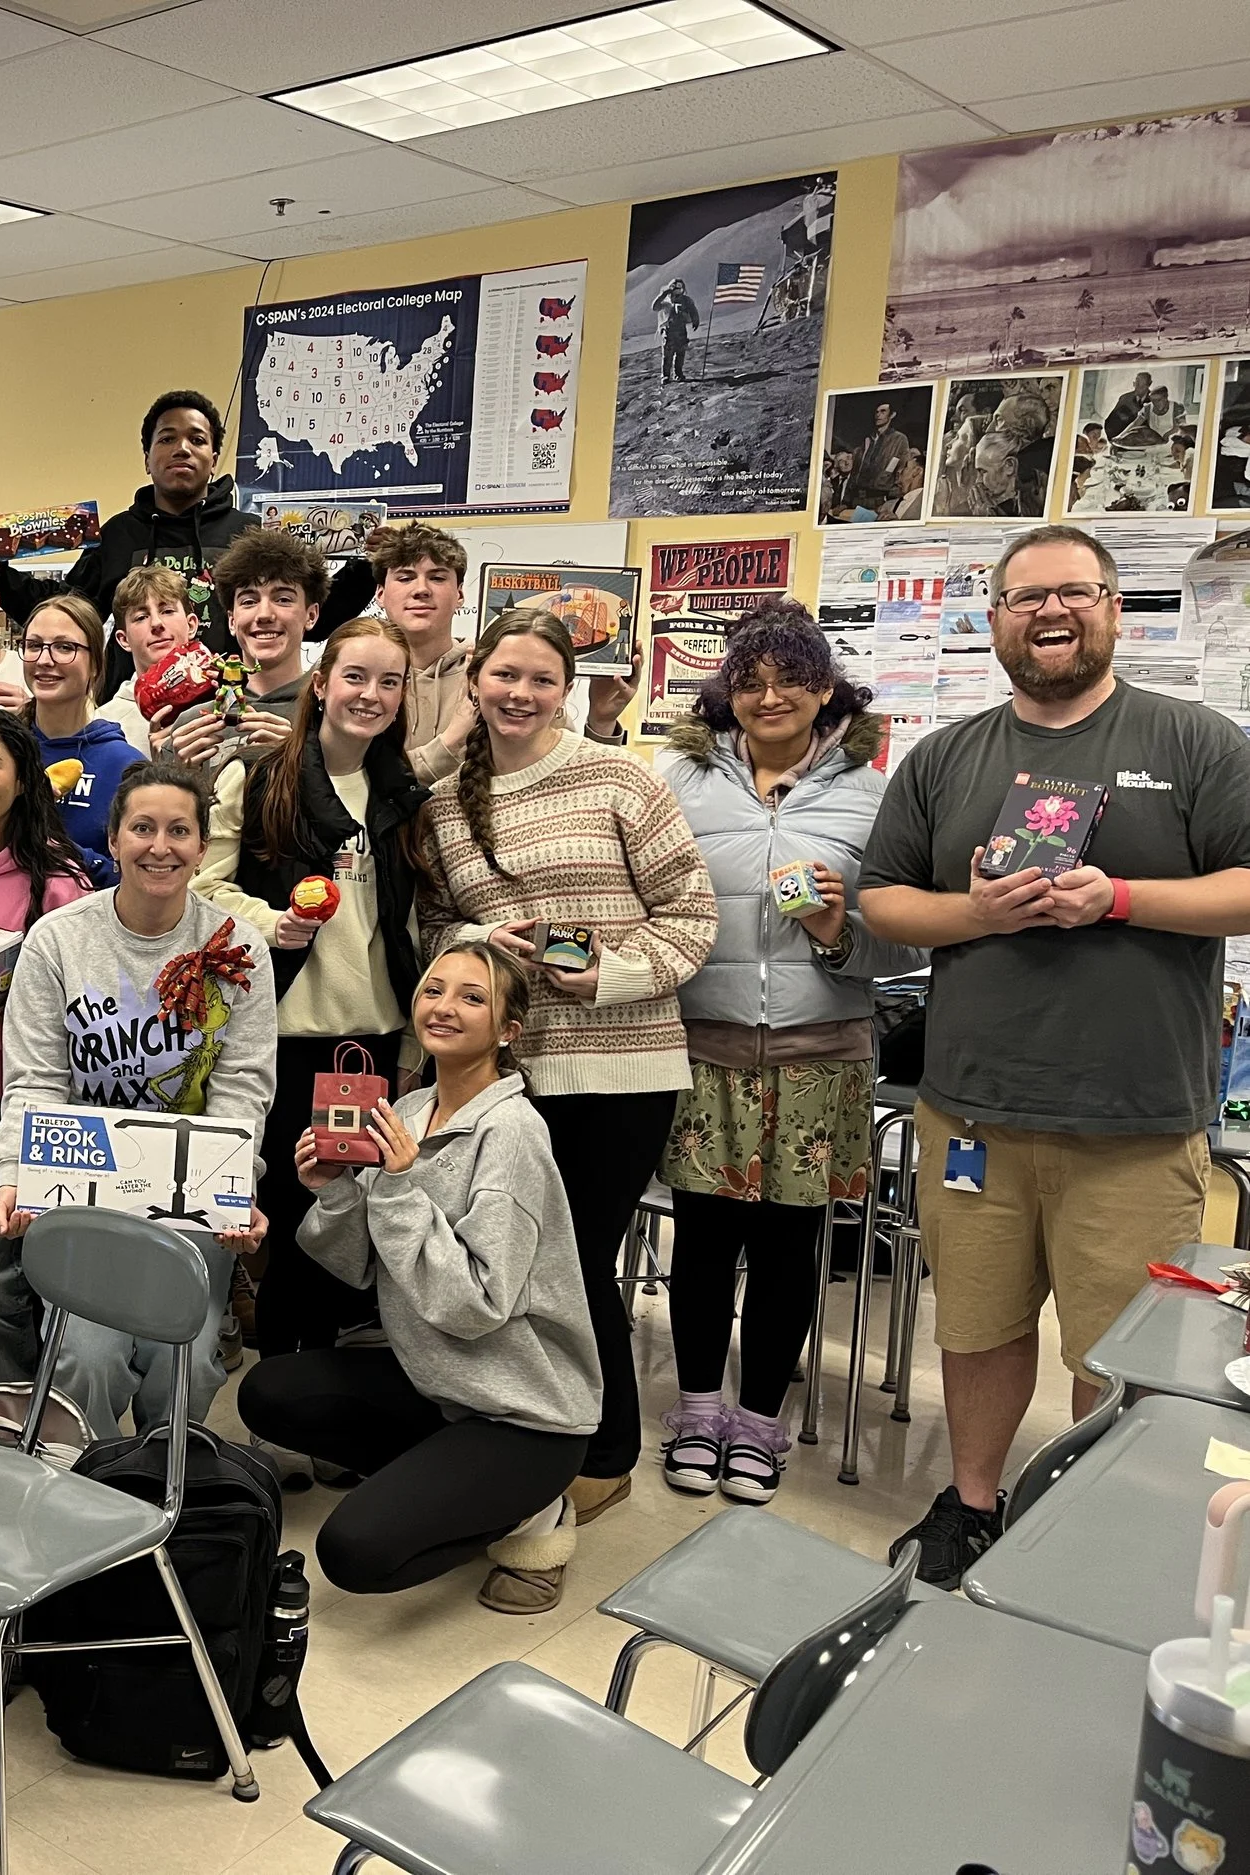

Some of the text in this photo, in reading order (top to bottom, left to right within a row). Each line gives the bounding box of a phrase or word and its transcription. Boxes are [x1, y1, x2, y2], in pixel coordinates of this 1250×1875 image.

[309, 304, 334, 319] 2024
[337, 298, 385, 316] Electoral
[387, 294, 431, 308] College
[435, 289, 463, 304] Map
[628, 463, 649, 471] difficult
[685, 474, 716, 483] yesterday
[736, 473, 753, 481] hope
[763, 471, 784, 479] today
[736, 488, 757, 496] reality
[17, 509, 57, 524] Cosmic
[9, 517, 66, 537] Brownies
[659, 546, 726, 585] WE THE
[696, 547, 782, 587] PEOPLE
[490, 575, 561, 591] BASKETBALL
[693, 595, 731, 609] UNITED
[684, 639, 717, 654] PERFECT
[670, 647, 717, 667] ESTABLISH
[649, 711, 682, 719] UNITED
[1117, 770, 1151, 781] Black
[1030, 782, 1088, 796] BOUQUET
[1045, 780, 1076, 788] BLOCK
[1117, 780, 1172, 790] Mountain
[550, 929, 574, 940] PARK
[551, 924, 576, 932] SOUTH
[67, 994, 119, 1029] The
[71, 1010, 186, 1073] GRINCH
[110, 1056, 145, 1078] and
[82, 1077, 155, 1108] MAX
[36, 1118, 75, 1126] TABLETOP
[31, 1127, 97, 1148] HOOK
[29, 1145, 106, 1166] & RING
